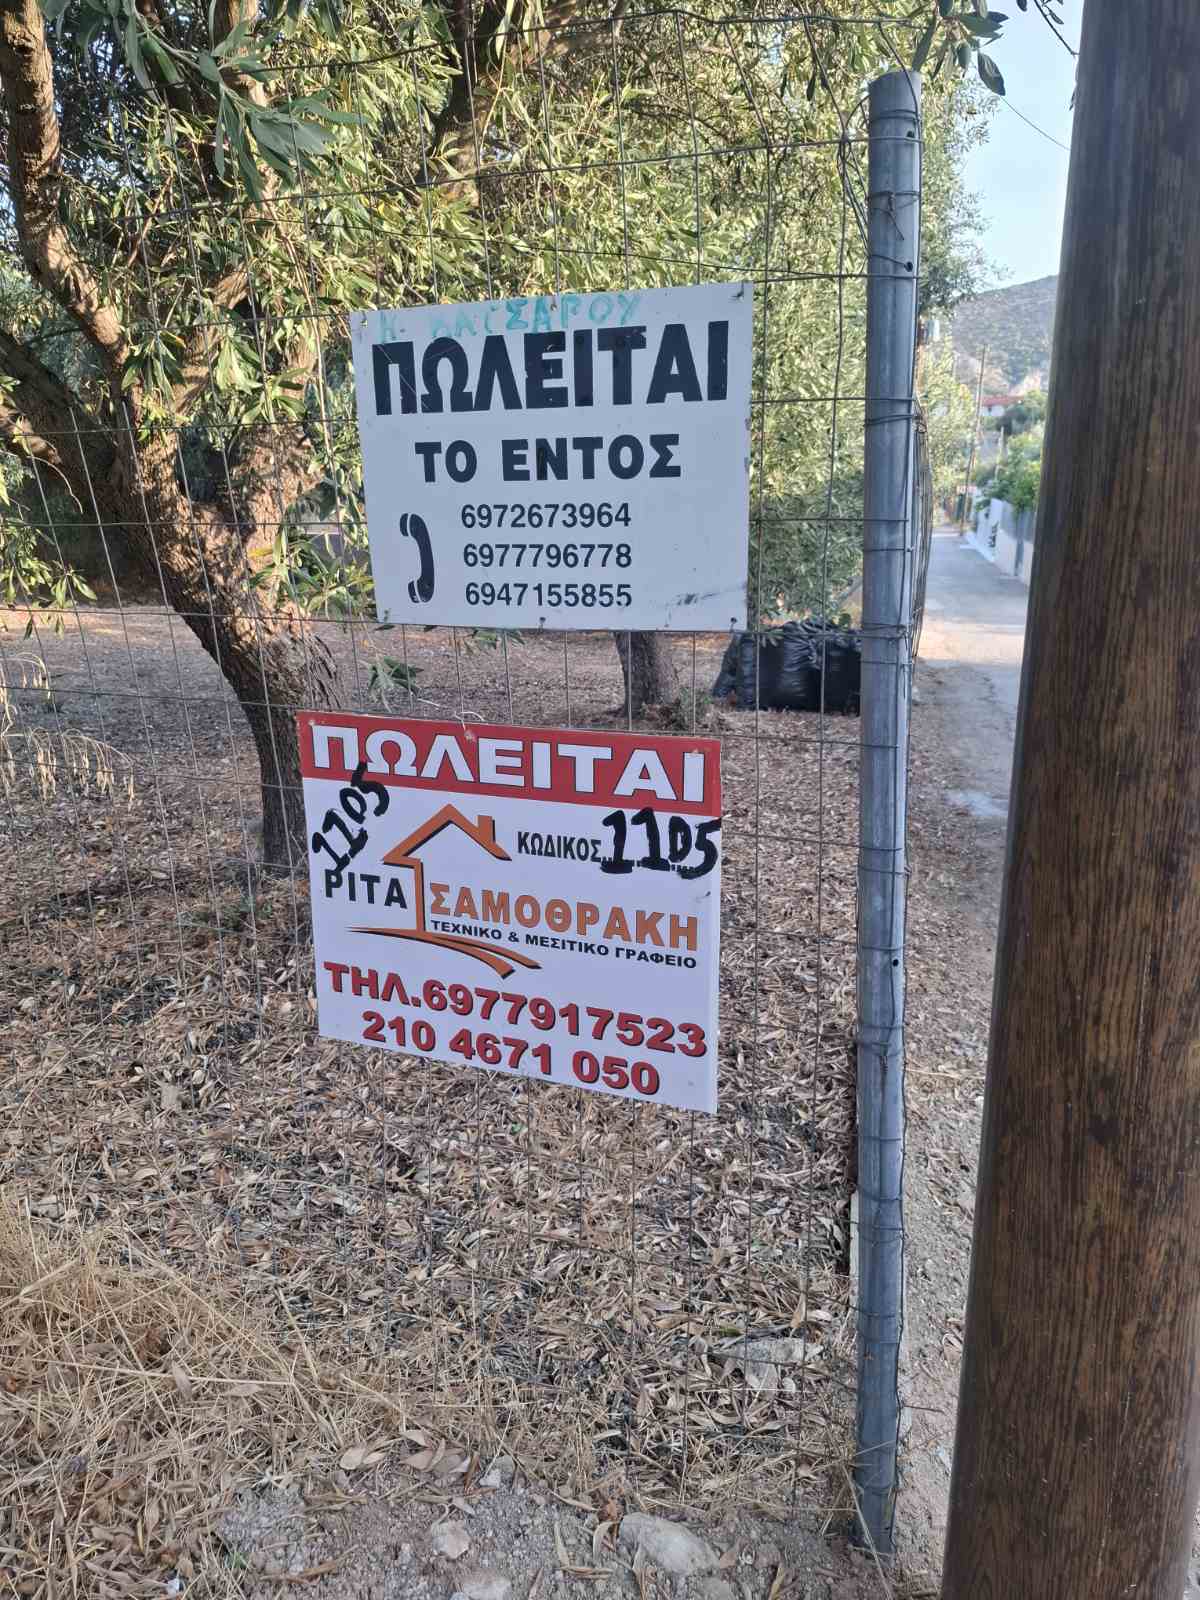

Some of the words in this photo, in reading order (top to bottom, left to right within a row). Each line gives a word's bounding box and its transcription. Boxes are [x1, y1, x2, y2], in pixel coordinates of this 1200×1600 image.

[372, 320, 729, 416] ΠΩΛΕΙΤΑΙ
[414, 440, 477, 483] ΤΟ
[501, 433, 682, 481] ΕΝΤΟΣ
[461, 502, 631, 528] 6972673964
[463, 543, 632, 568] 6977796778
[465, 582, 632, 608] 6947155855
[311, 725, 705, 803] ΠΩΛΕΙΤΑΙ
[312, 762, 390, 872] 1105
[602, 807, 721, 880] 1105
[324, 868, 408, 909] ΡΙΤΑ
[429, 882, 698, 951] ΣΑΜΟΘΡΑΚΗ
[430, 919, 502, 941] ΤΕΧΝΙΚΟ
[508, 932, 519, 944] &
[525, 934, 609, 957] ΜΕΣΙΤΙΚΟ
[614, 947, 697, 969] ΓΡΑΦΕΙΟ
[361, 1010, 436, 1052] 210
[448, 1028, 553, 1076] 4671
[572, 1049, 661, 1096] 050
